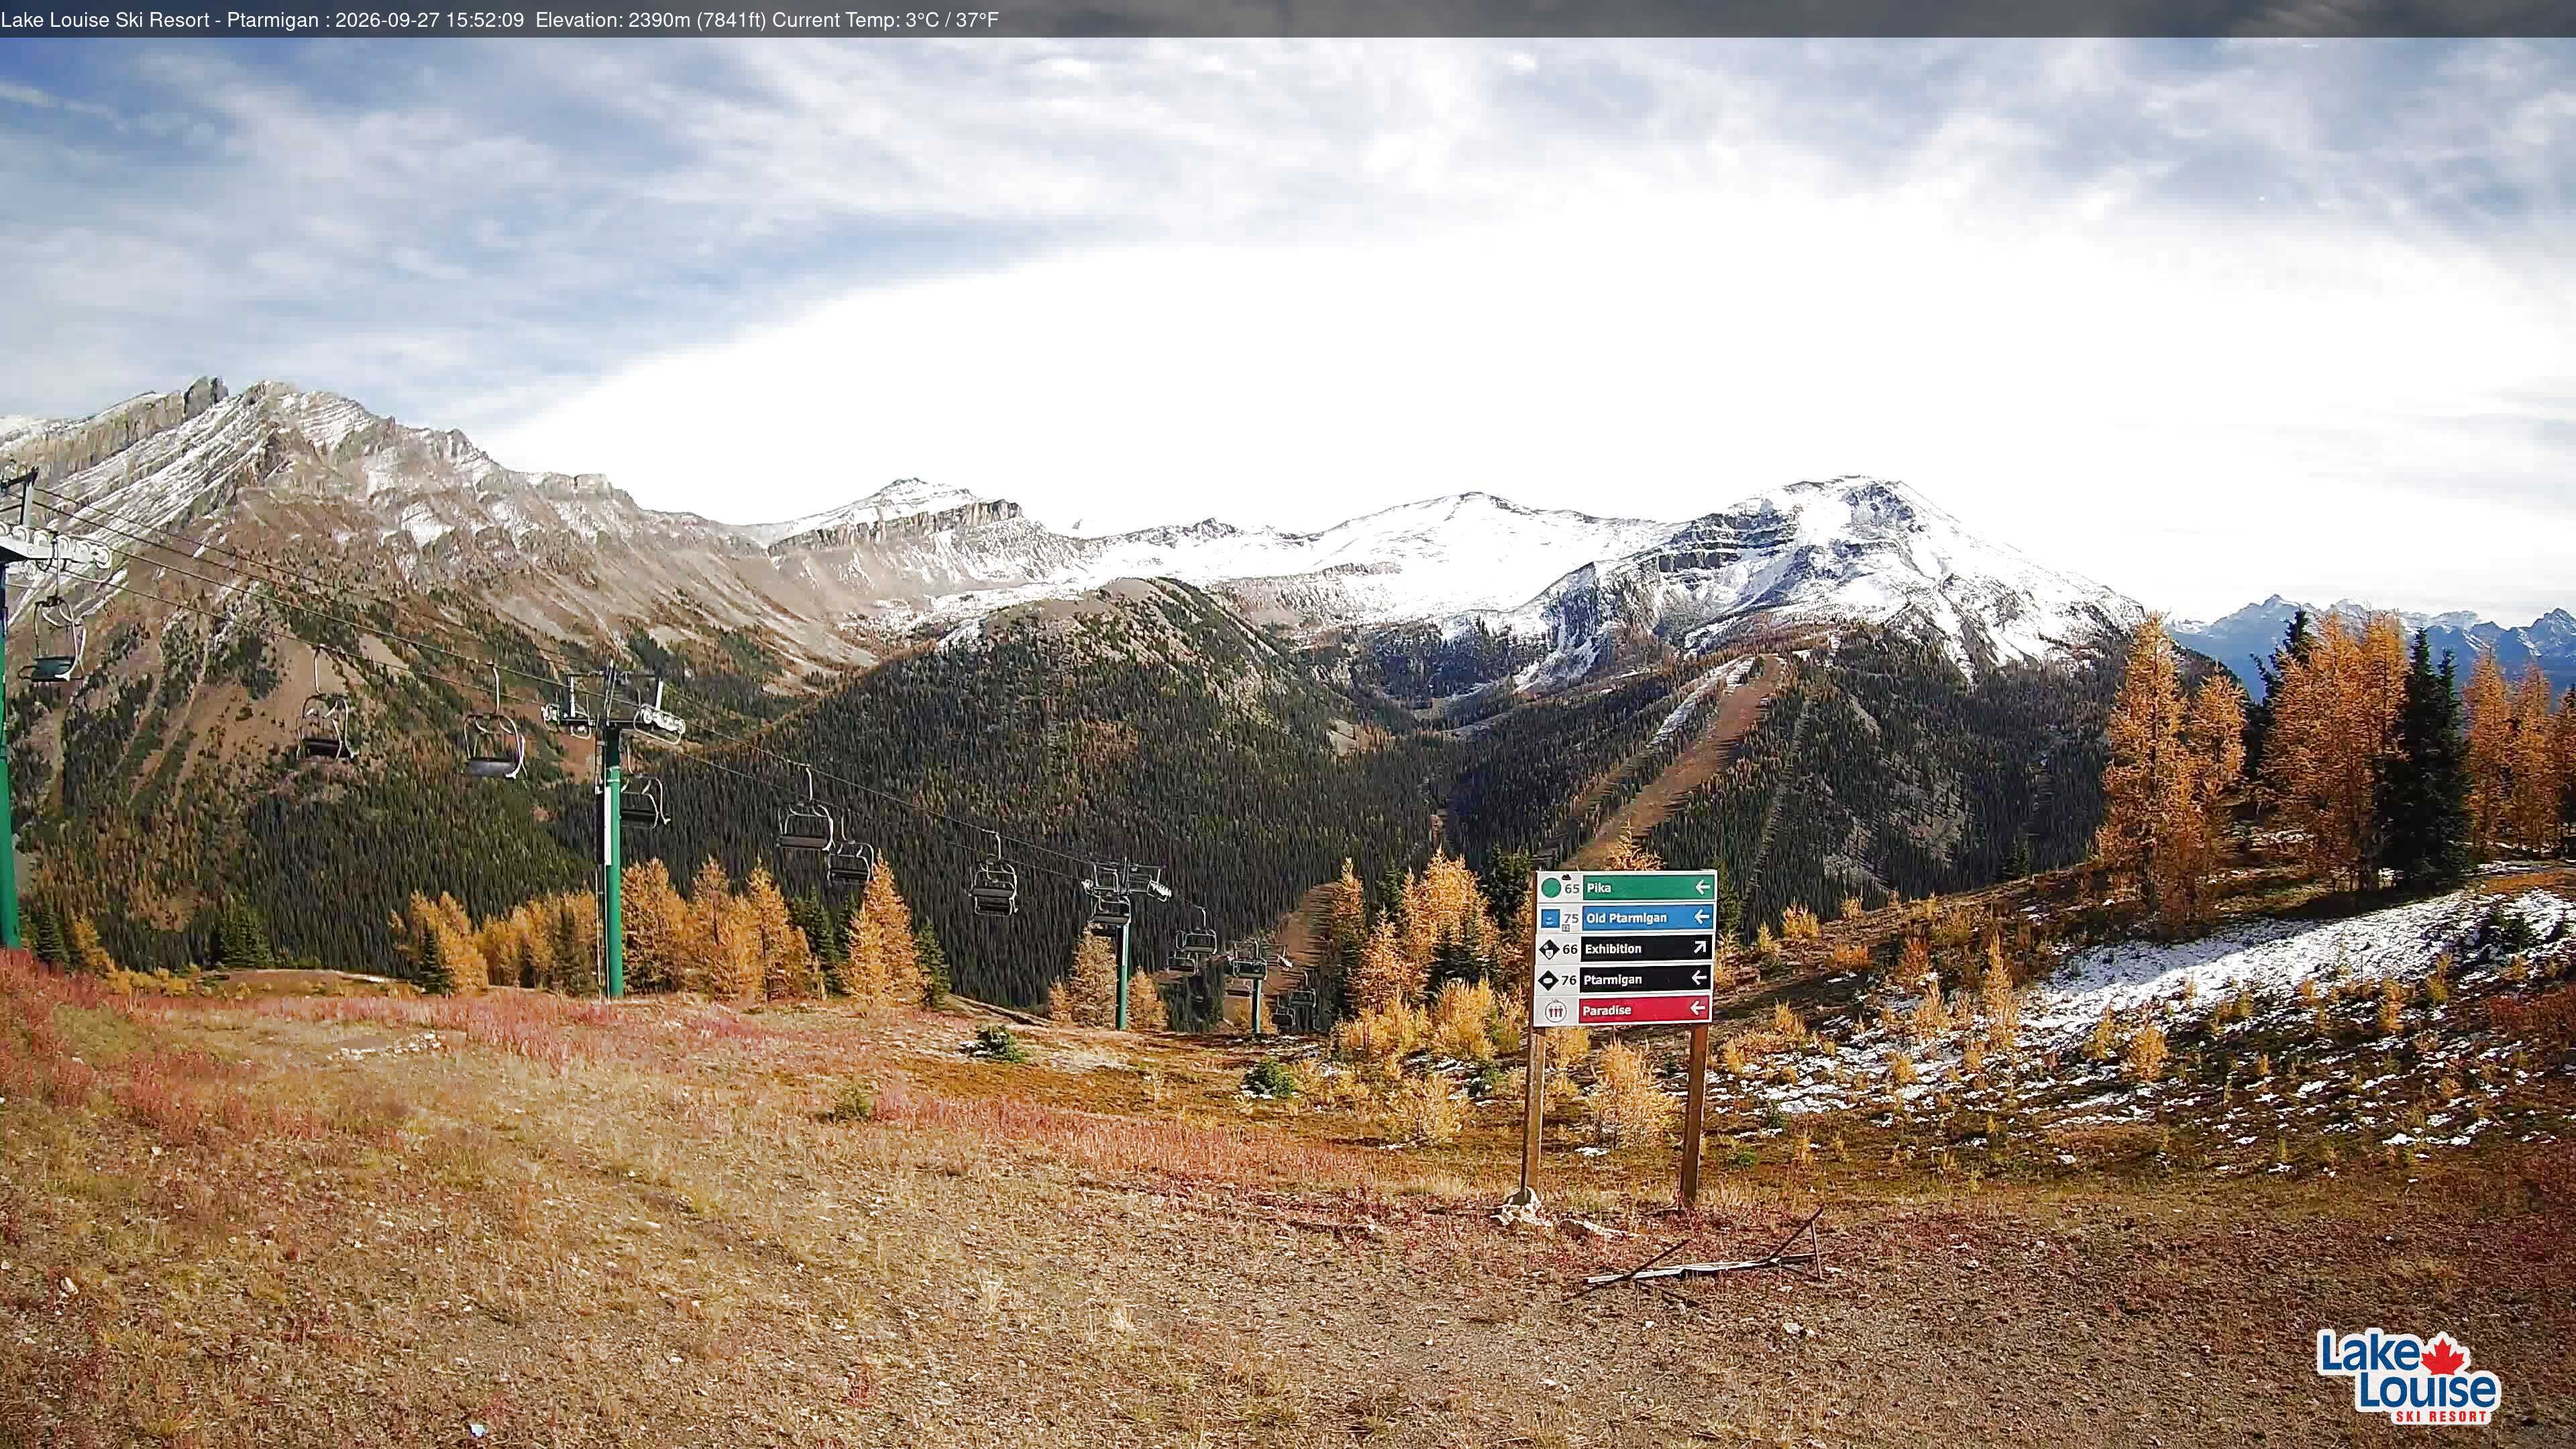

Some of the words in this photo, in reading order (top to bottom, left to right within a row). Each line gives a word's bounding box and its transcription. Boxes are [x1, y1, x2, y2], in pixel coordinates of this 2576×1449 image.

[1564, 883, 1580, 894] 65
[1587, 882, 1611, 894] Pika
[1564, 913, 1579, 924] 75
[1586, 912, 1606, 924] Old
[1609, 912, 1668, 925] Ptarmigan
[1562, 944, 1578, 955] 66
[1585, 943, 1642, 955] Exhibition
[1561, 975, 1577, 985] 76
[1584, 974, 1642, 987] Ptarmigan
[1582, 1005, 1631, 1016] Paradise
